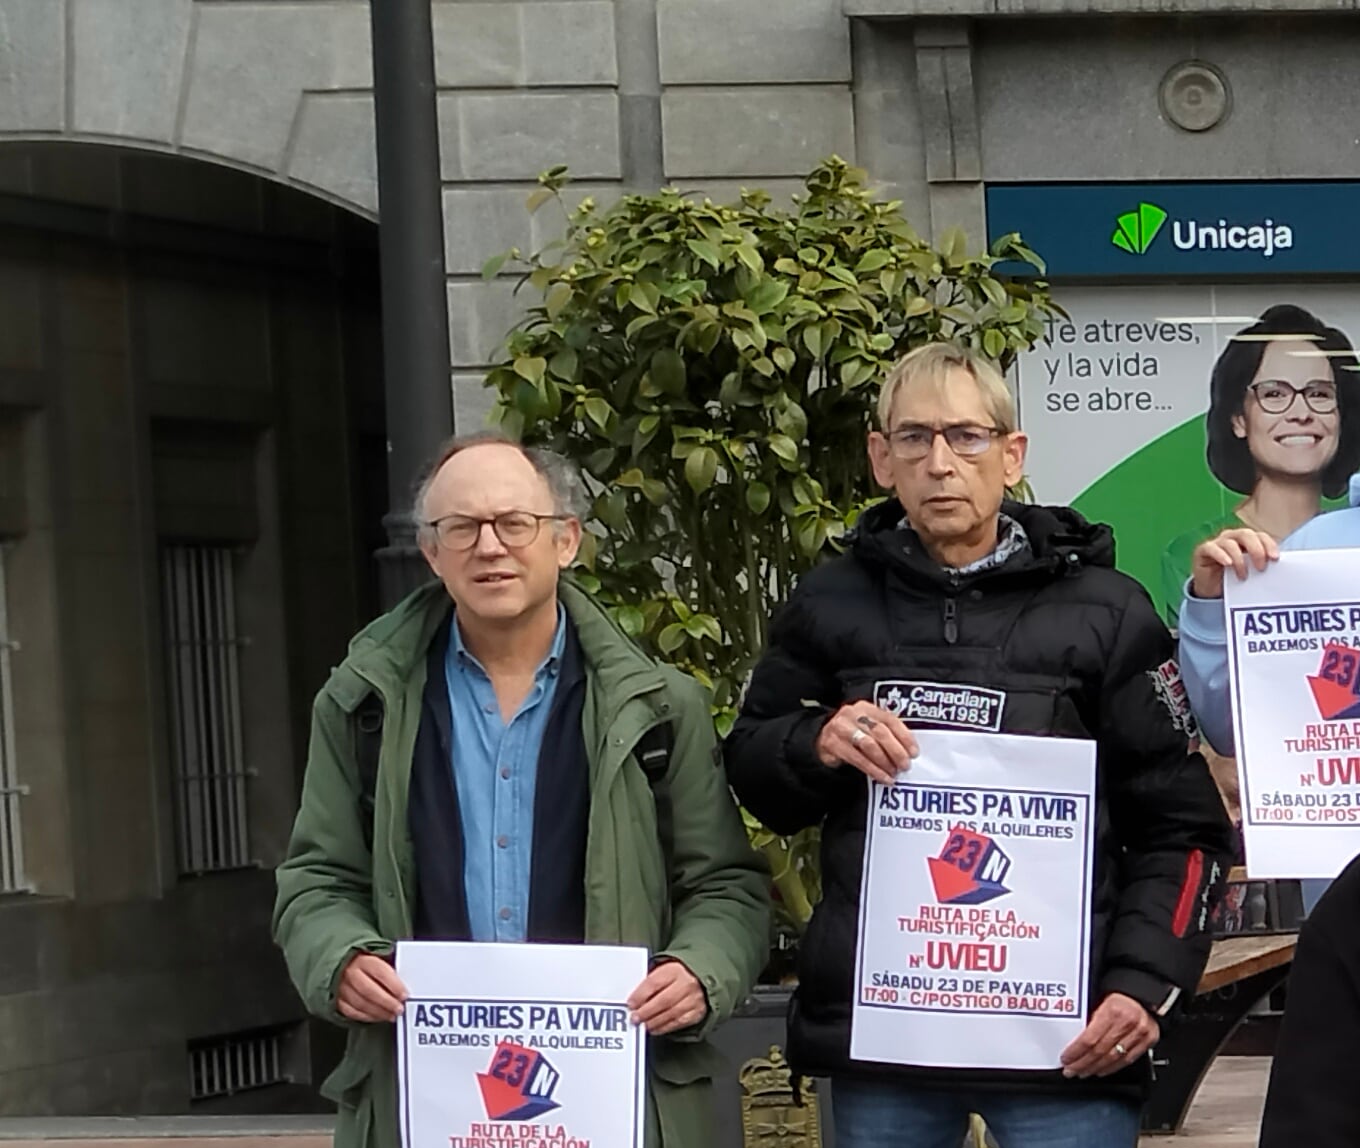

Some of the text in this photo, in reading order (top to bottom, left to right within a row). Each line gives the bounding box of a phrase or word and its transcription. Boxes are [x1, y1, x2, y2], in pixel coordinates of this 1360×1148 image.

[1173, 220, 1293, 256] Unicaja
[1045, 318, 1201, 345] Te atreves,
[1045, 352, 1158, 384] y la vida
[1046, 387, 1172, 412] se abre...
[1244, 608, 1345, 635] ASTURIES
[907, 701, 990, 725] Peak1983
[1305, 723, 1349, 738] RUTA
[879, 787, 1076, 820] ASTURIES PA VIVIR
[864, 986, 898, 1002] 17:00
[909, 991, 1002, 1009] C/POSTIGO
[1006, 996, 1049, 1011] BAJO
[1053, 999, 1074, 1012] 46
[413, 1004, 626, 1031] ASTURIES PA VIVIR
